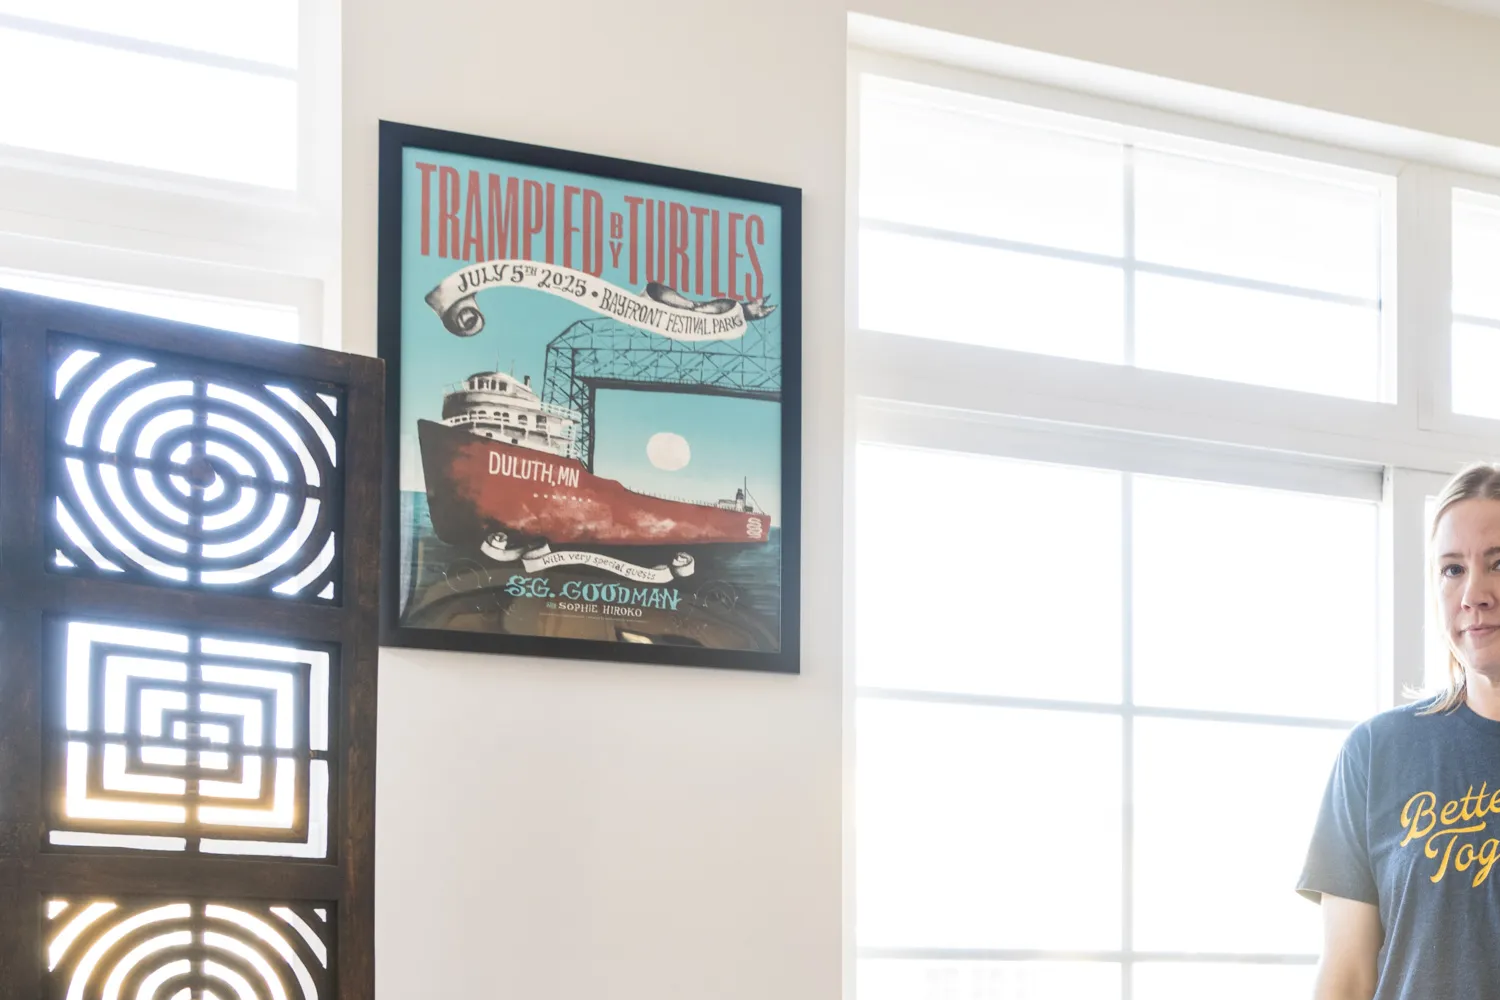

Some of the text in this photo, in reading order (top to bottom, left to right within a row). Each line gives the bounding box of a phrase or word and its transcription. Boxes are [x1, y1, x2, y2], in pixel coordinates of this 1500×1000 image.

[415, 162, 764, 300] TRAMPLED BY TURTLES
[458, 264, 743, 335] JULY 5TH 2025 BAYFRONT FESTIVAL PARK
[488, 451, 580, 488] DULUTH, MN
[542, 552, 657, 581] With very special guests
[504, 575, 683, 611] S.G. GOODMAN
[558, 601, 598, 613] SOPHIE
[603, 604, 643, 617] HIROKO
